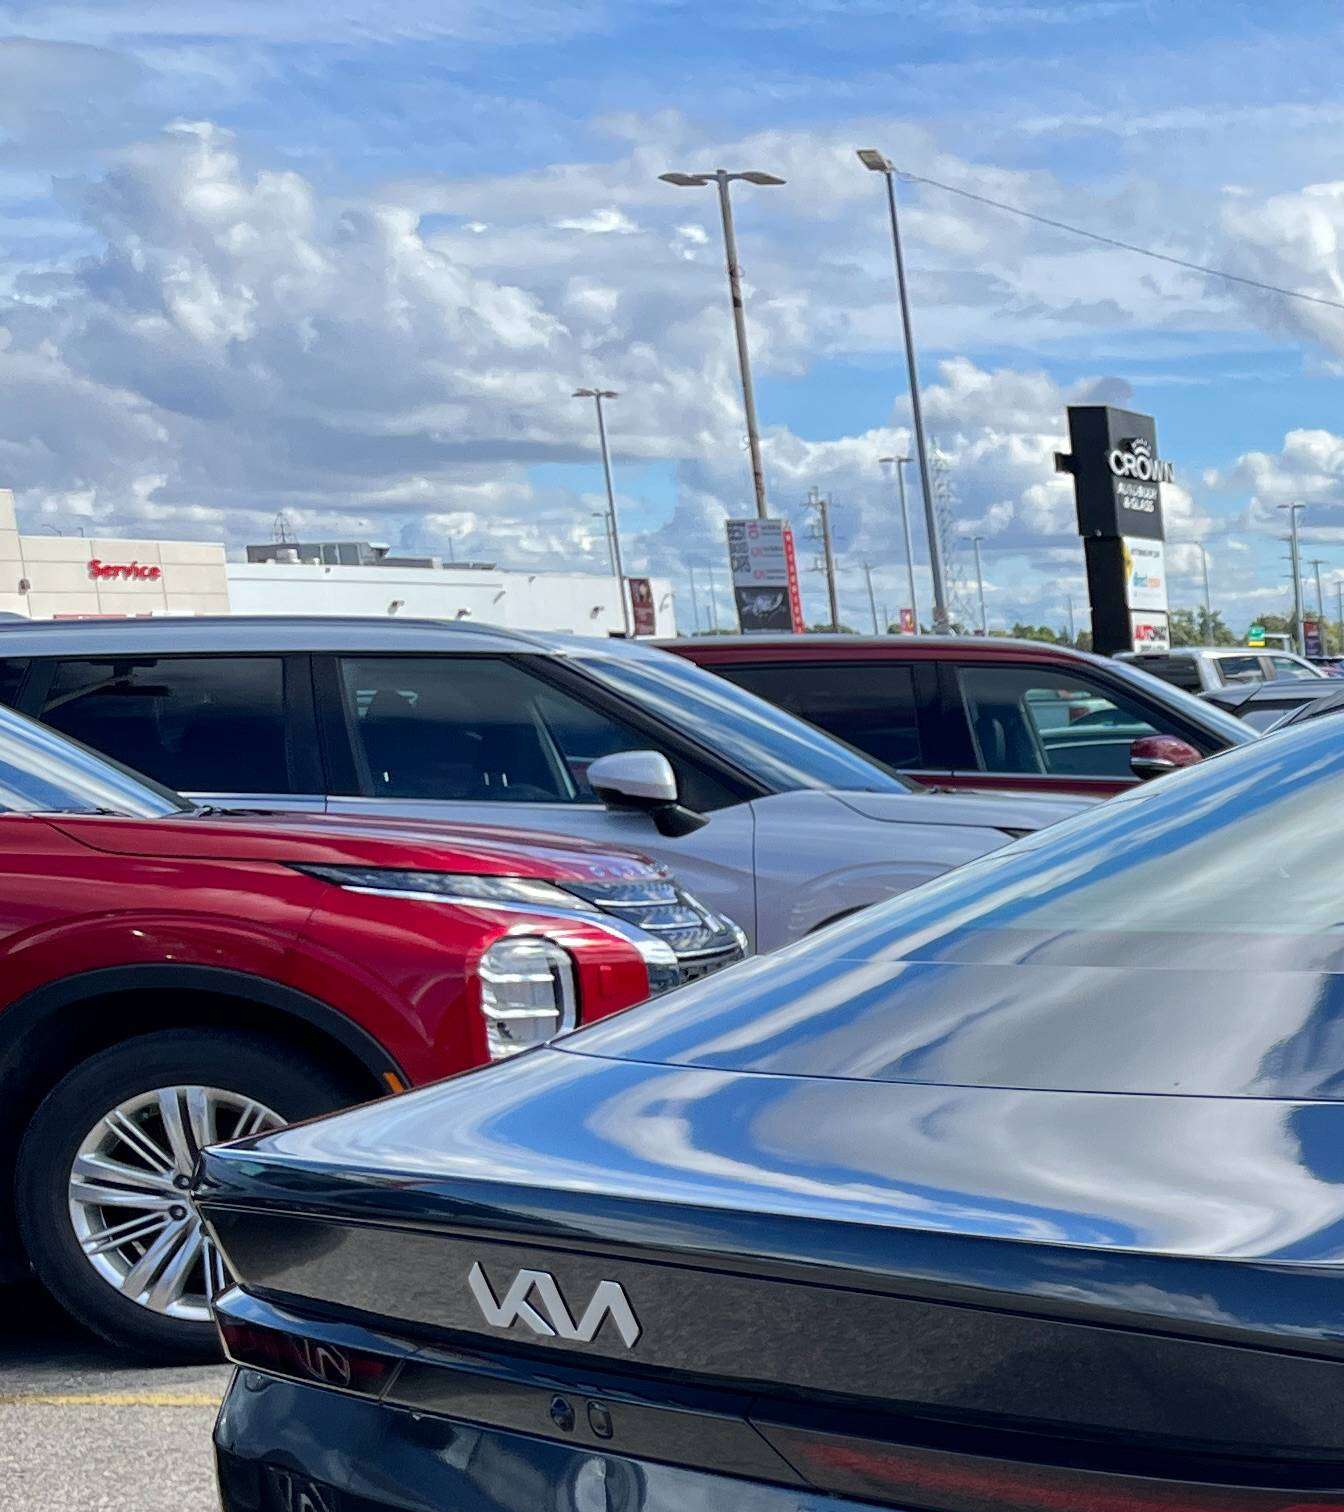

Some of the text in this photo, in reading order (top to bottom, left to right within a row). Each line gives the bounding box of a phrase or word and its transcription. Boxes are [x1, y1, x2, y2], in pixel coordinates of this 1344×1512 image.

[1109, 450, 1175, 482] CROWN
[87, 558, 161, 580] Service
[467, 1261, 642, 1350] KIA
